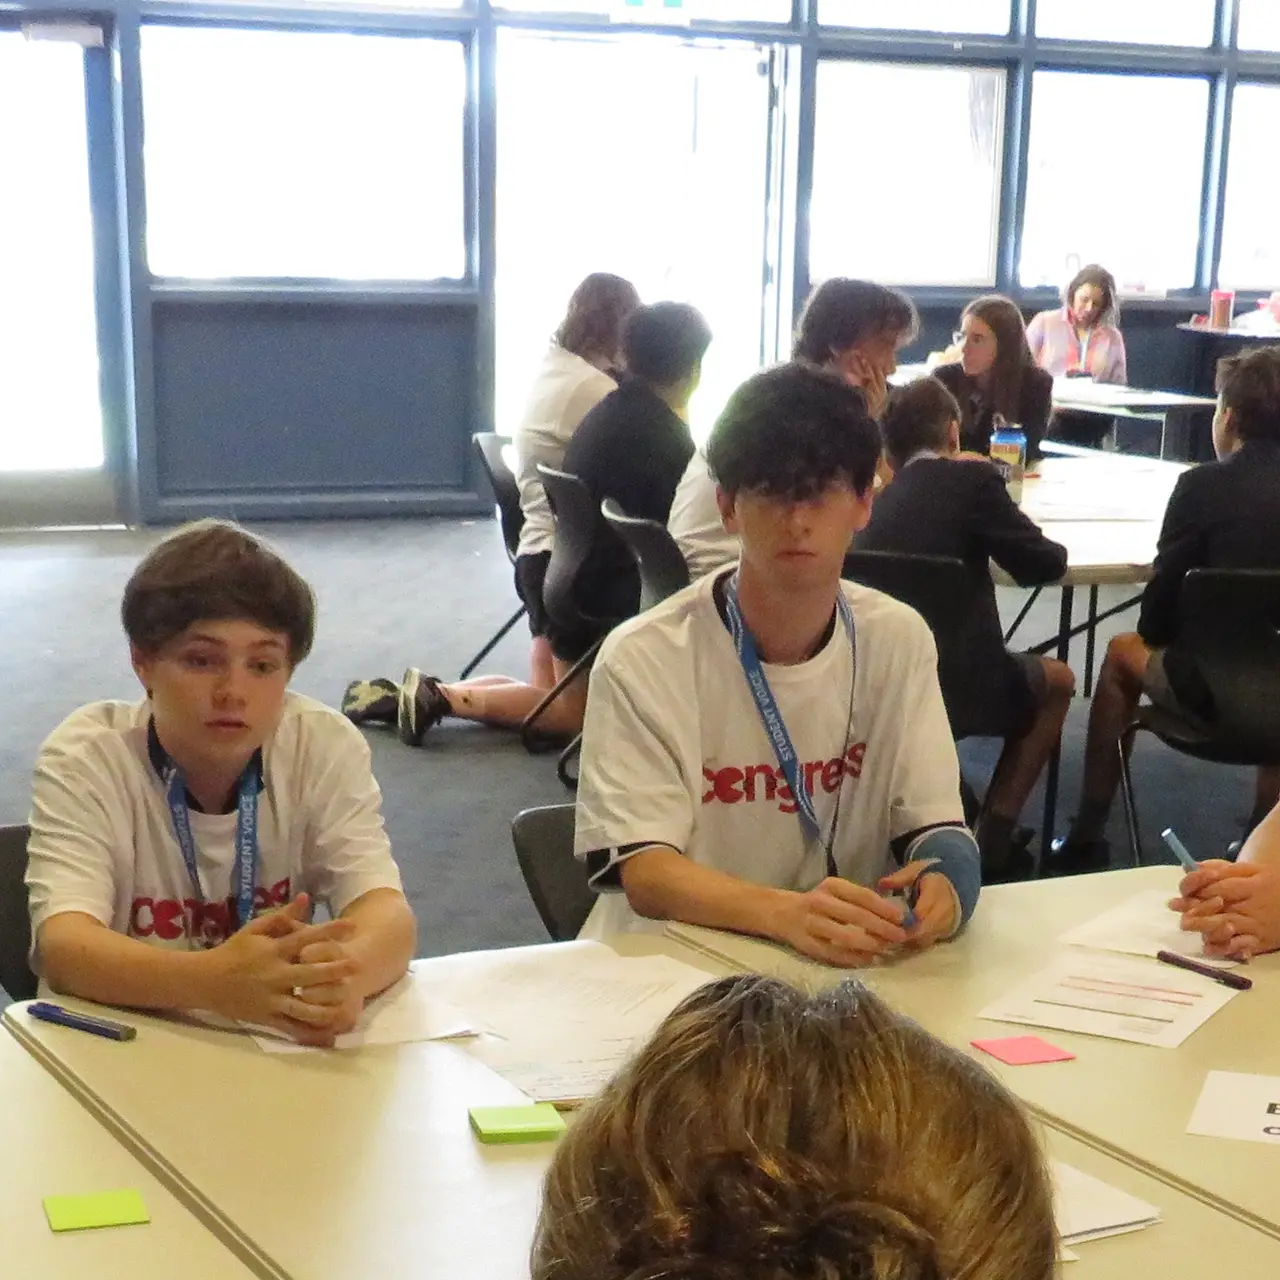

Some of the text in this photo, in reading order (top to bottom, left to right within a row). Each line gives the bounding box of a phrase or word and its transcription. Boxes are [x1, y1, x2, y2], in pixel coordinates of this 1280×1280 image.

[748, 669, 794, 762] STUDENT VOICE
[239, 795, 254, 900] STUDENT VOICE
